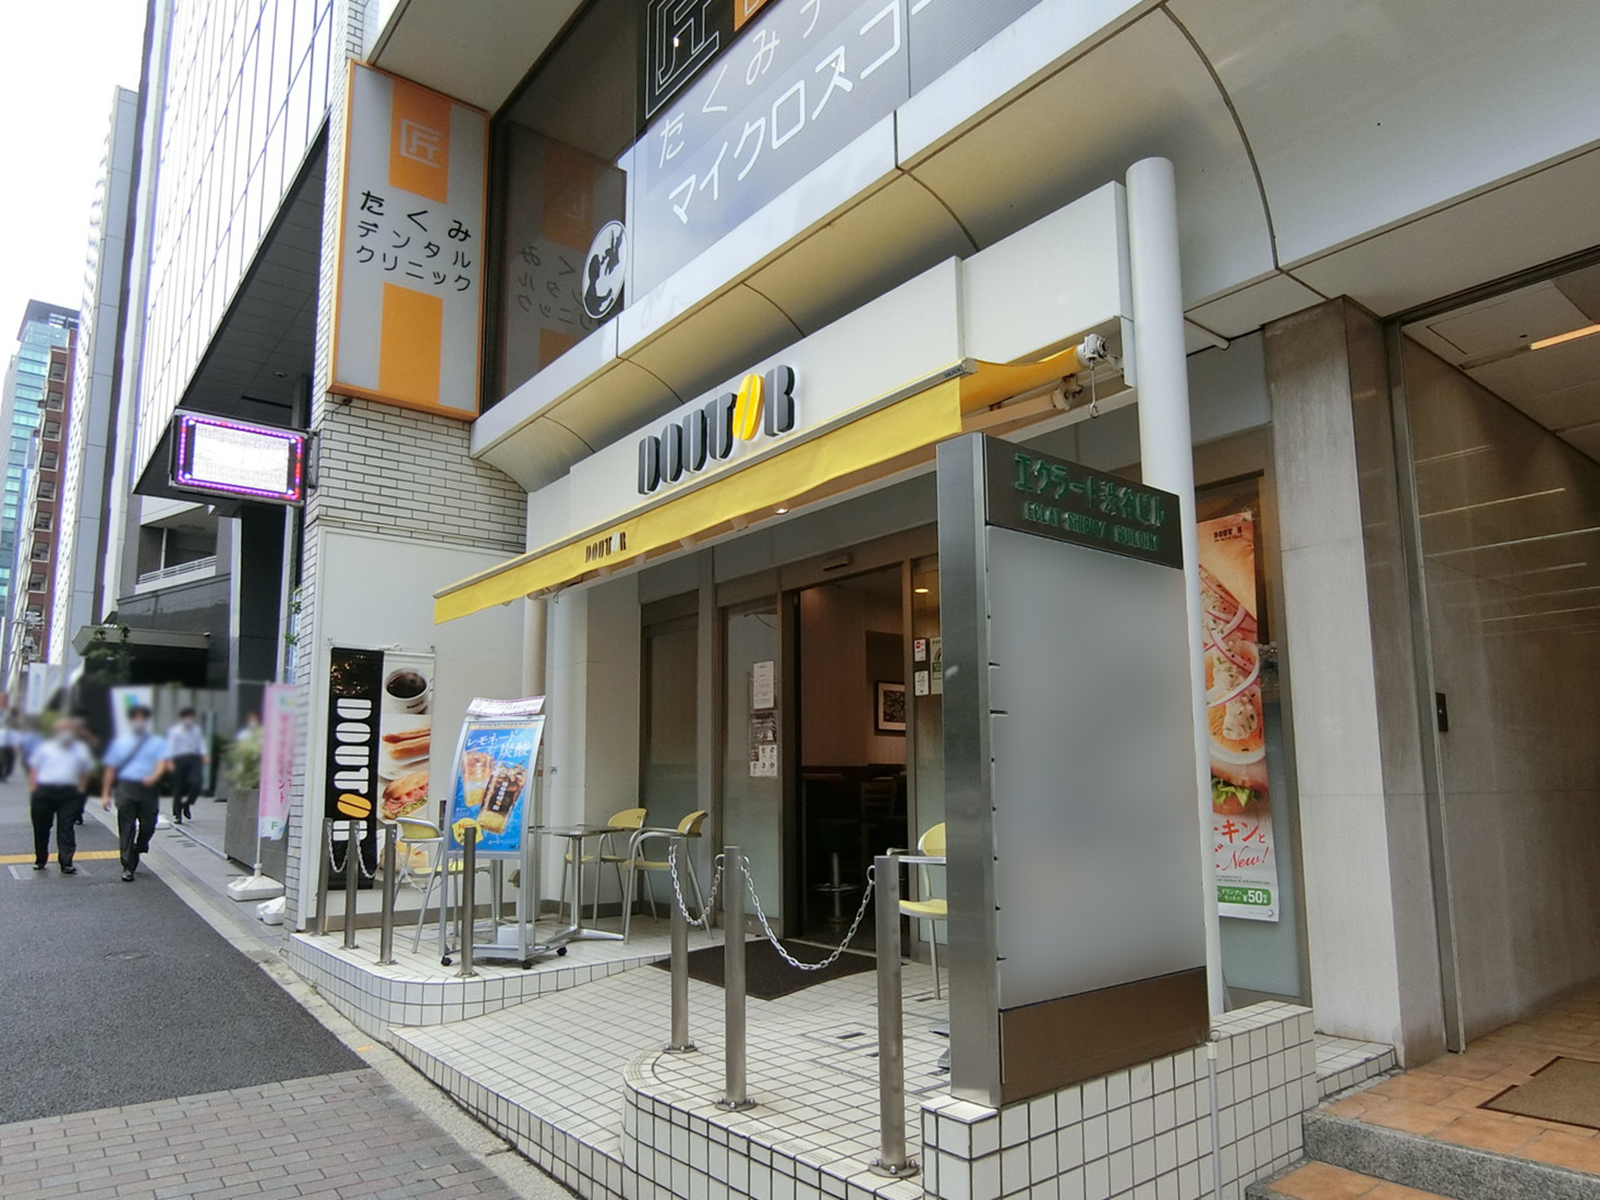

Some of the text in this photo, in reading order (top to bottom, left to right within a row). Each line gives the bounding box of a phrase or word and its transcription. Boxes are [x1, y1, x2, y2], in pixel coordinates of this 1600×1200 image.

[358, 189, 472, 243] たくみ
[355, 244, 471, 292] クリニック
[357, 219, 472, 269] デンタル
[638, 364, 796, 496] DOUTOR
[1213, 819, 1266, 844] キンと
[1221, 845, 1270, 871] New!
